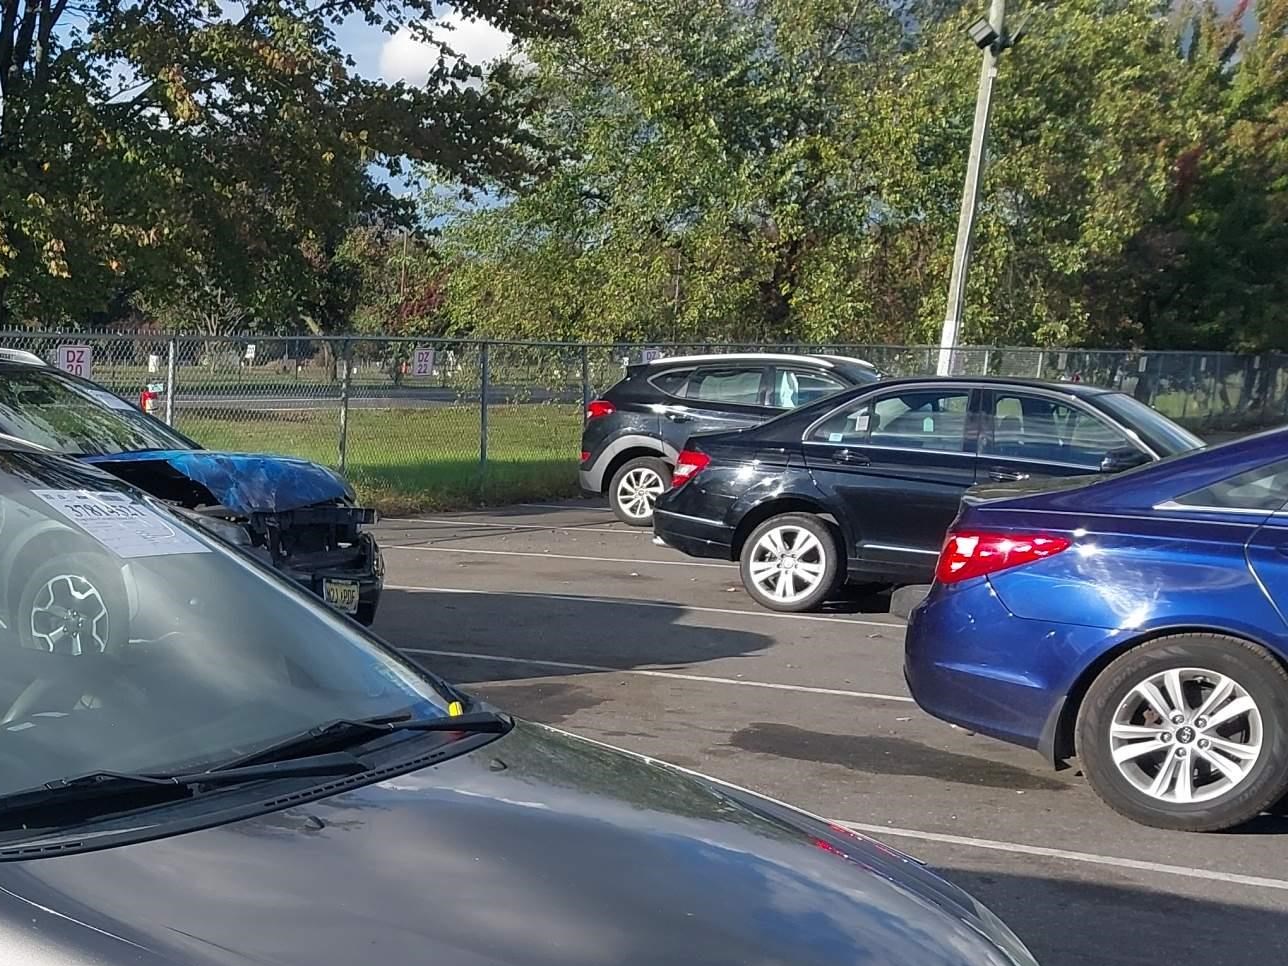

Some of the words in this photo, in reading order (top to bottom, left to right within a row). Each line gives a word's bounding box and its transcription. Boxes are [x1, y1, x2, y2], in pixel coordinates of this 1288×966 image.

[66, 350, 85, 364] DZ
[417, 351, 430, 363] DZ
[646, 351, 657, 361] DZ
[417, 363, 429, 374] 22
[64, 503, 147, 518] 37814521
